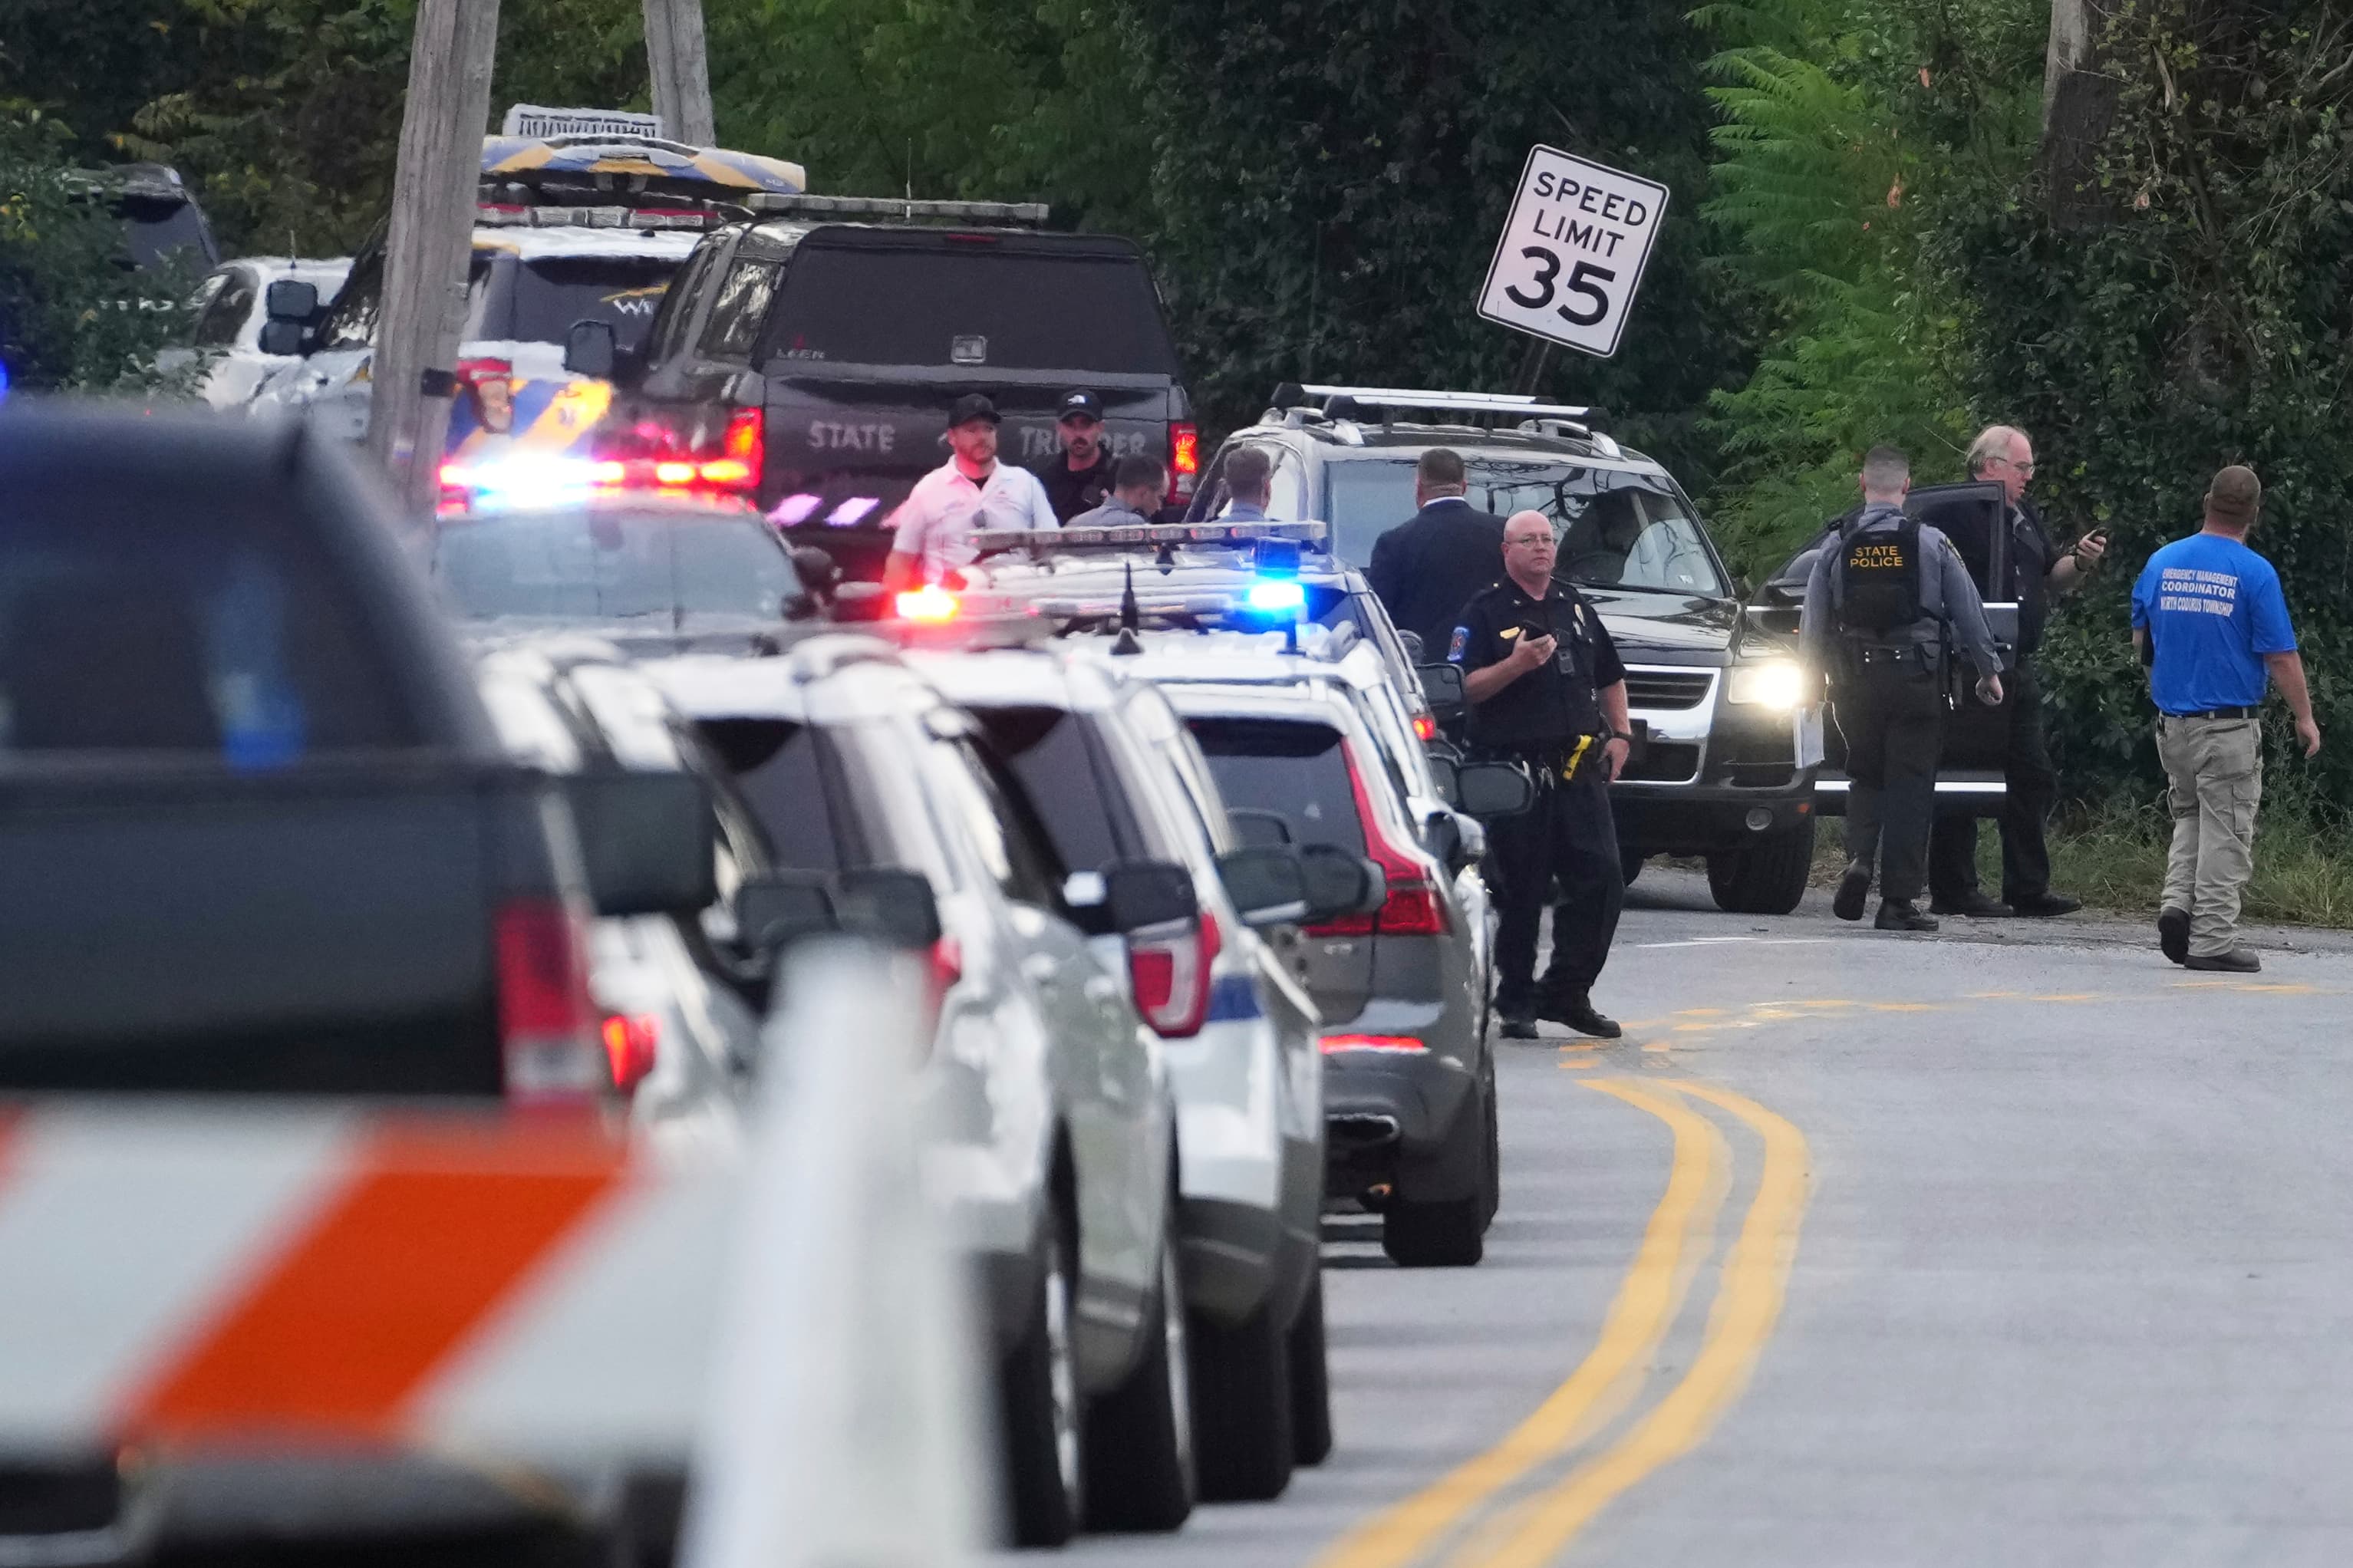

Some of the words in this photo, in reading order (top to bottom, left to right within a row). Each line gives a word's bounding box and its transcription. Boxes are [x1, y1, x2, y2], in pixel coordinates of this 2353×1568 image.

[1533, 171, 1647, 226] SPEED
[1533, 208, 1625, 258] LIMIT
[1504, 245, 1616, 326] 35
[809, 420, 895, 452] STATE
[1019, 426, 1146, 458] TRPER
[1855, 545, 1898, 557] STATE
[1850, 557, 1903, 568] POLICE
[2196, 570, 2238, 587] MANAGEMENT
[2161, 581, 2236, 599] COORDINATOR
[2203, 598, 2233, 617] TOWNSHIP
